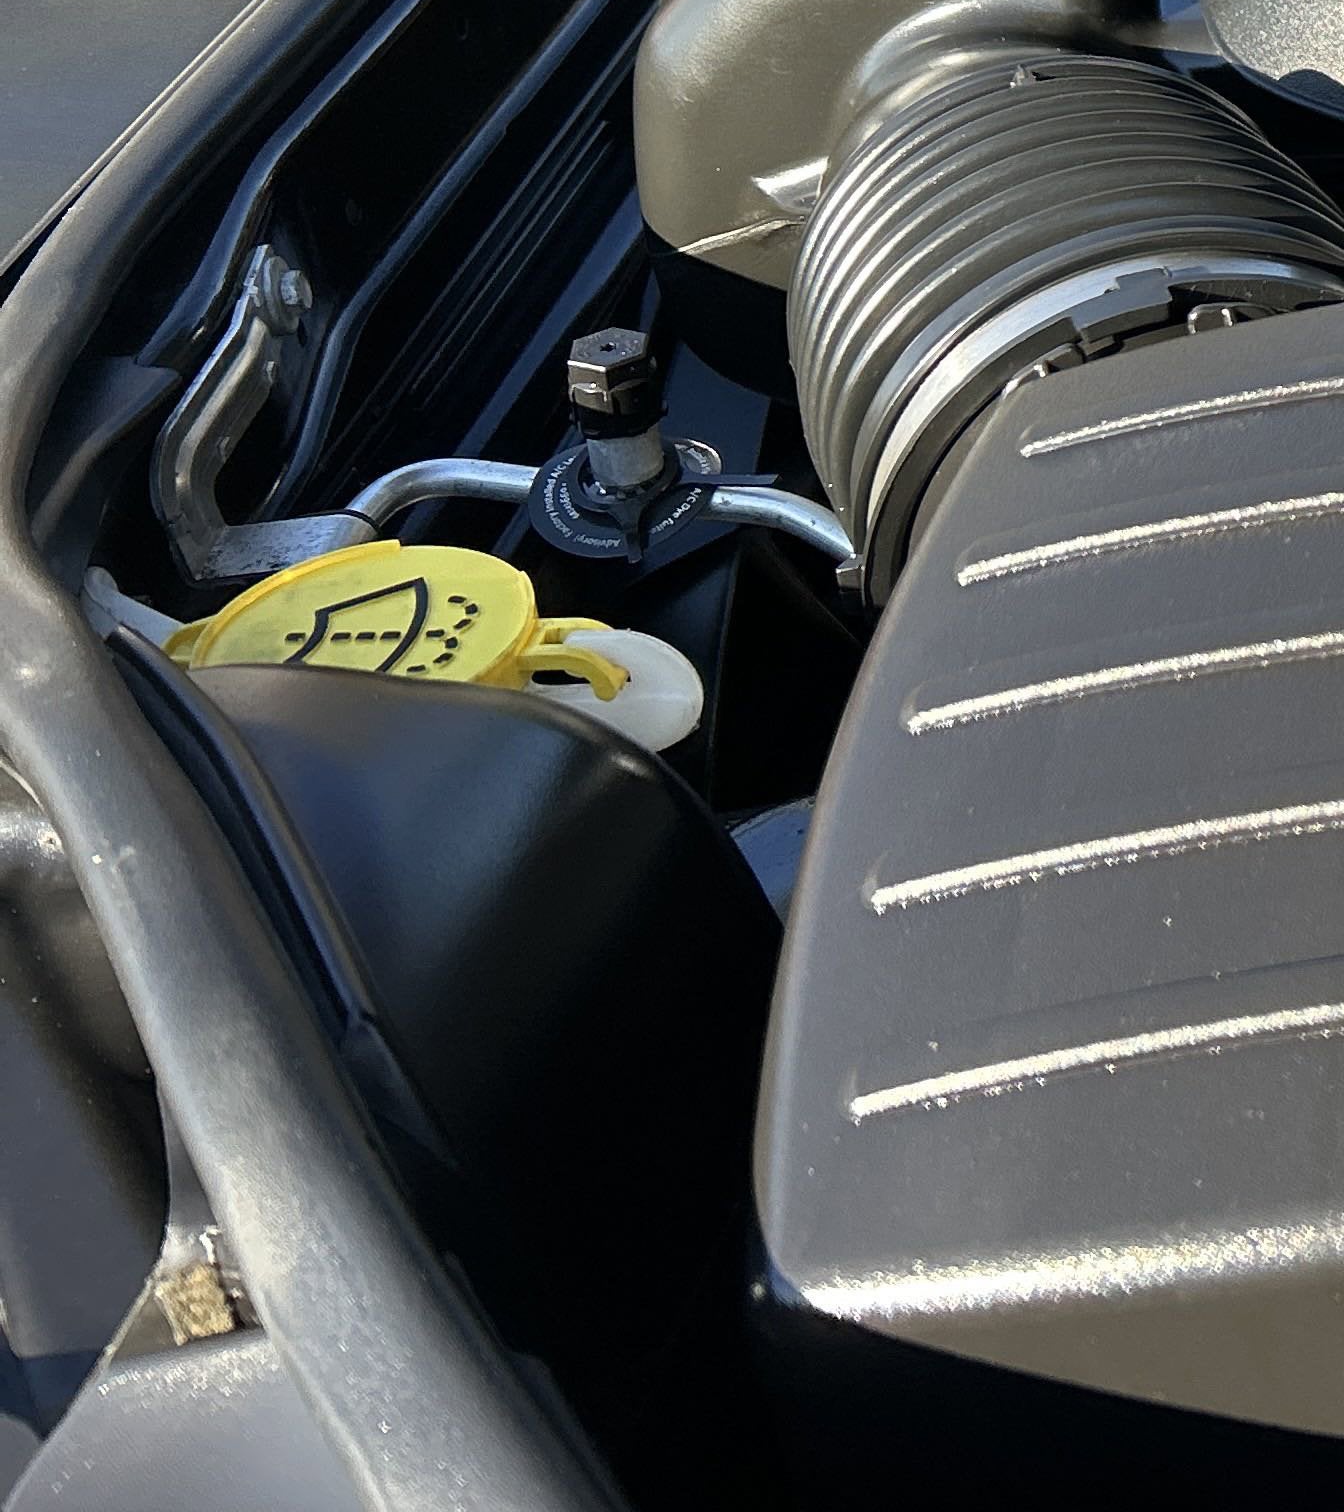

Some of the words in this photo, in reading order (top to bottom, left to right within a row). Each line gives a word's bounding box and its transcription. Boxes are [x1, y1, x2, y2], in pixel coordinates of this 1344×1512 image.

[550, 463, 567, 479] A/C
[543, 477, 558, 513] Installed
[686, 487, 702, 503] A/C
[672, 502, 691, 519] Dye
[549, 511, 576, 539] Factory
[574, 533, 622, 548] Advisory!
